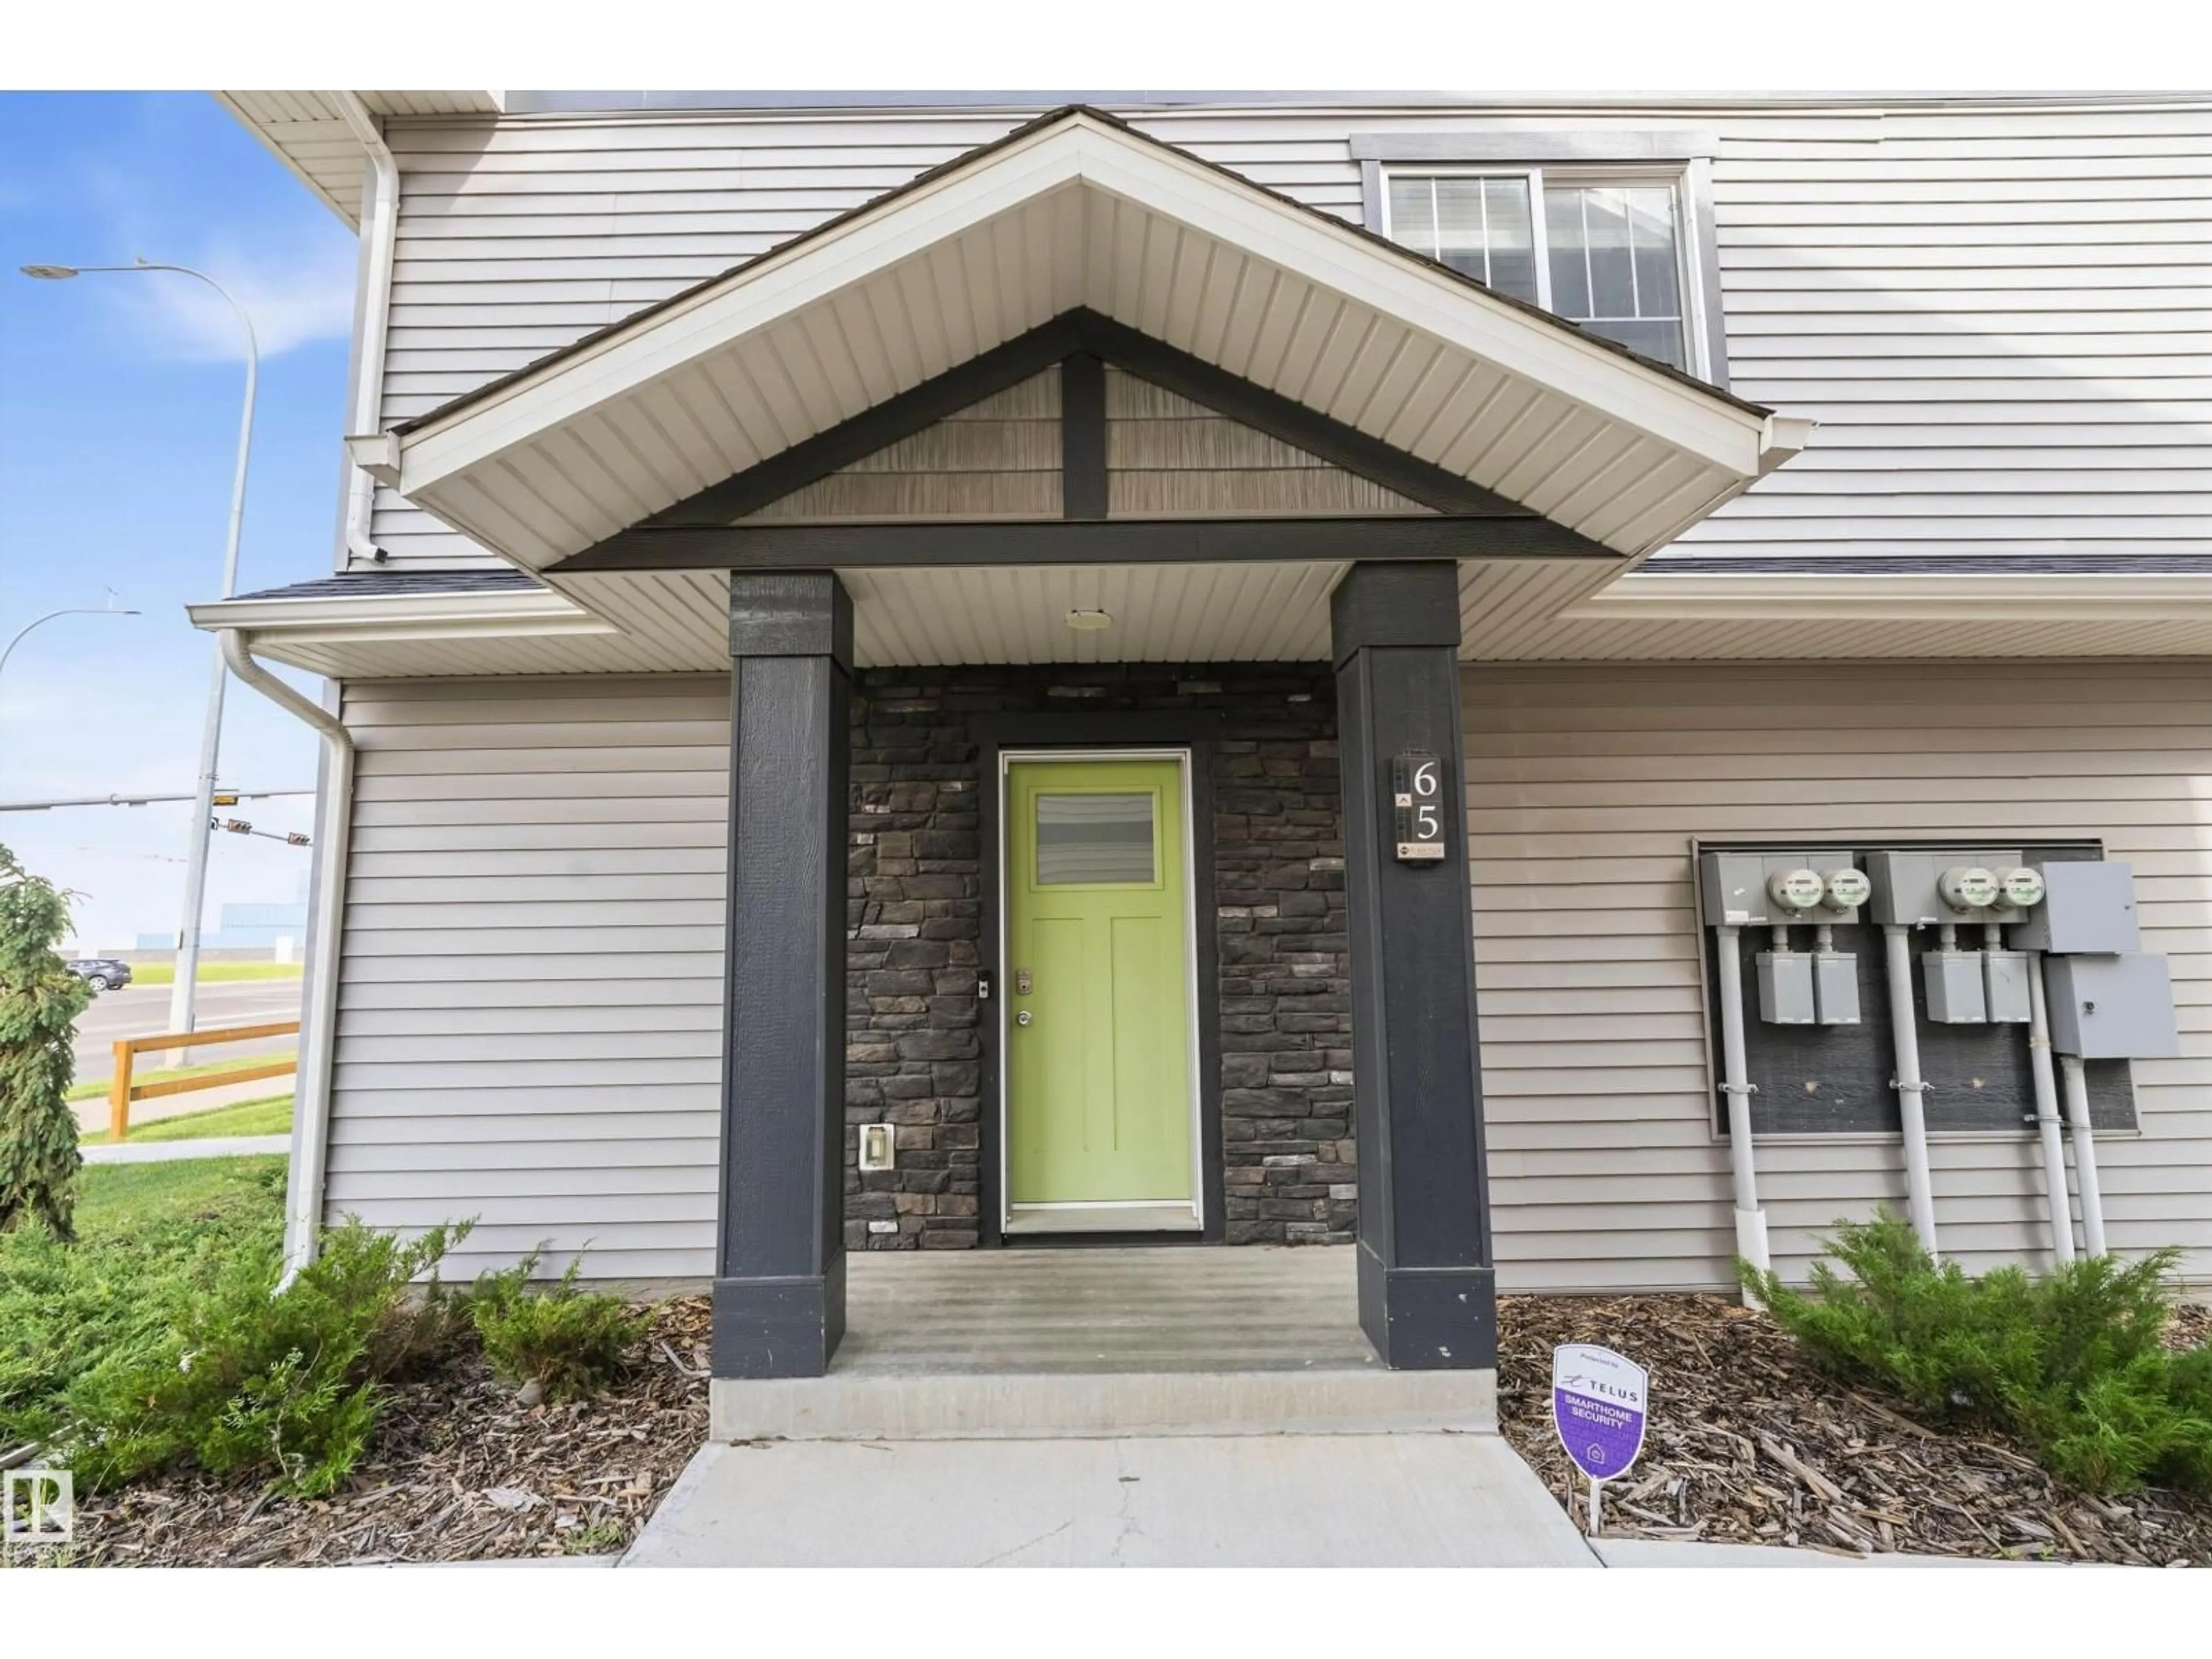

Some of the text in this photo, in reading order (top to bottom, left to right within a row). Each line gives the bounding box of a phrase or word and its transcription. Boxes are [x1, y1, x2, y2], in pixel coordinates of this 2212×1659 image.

[1590, 1380, 1638, 1402] TELUS
[1565, 1395, 1632, 1422] SMARTHOME
[1571, 1406, 1623, 1430] SECURITY
